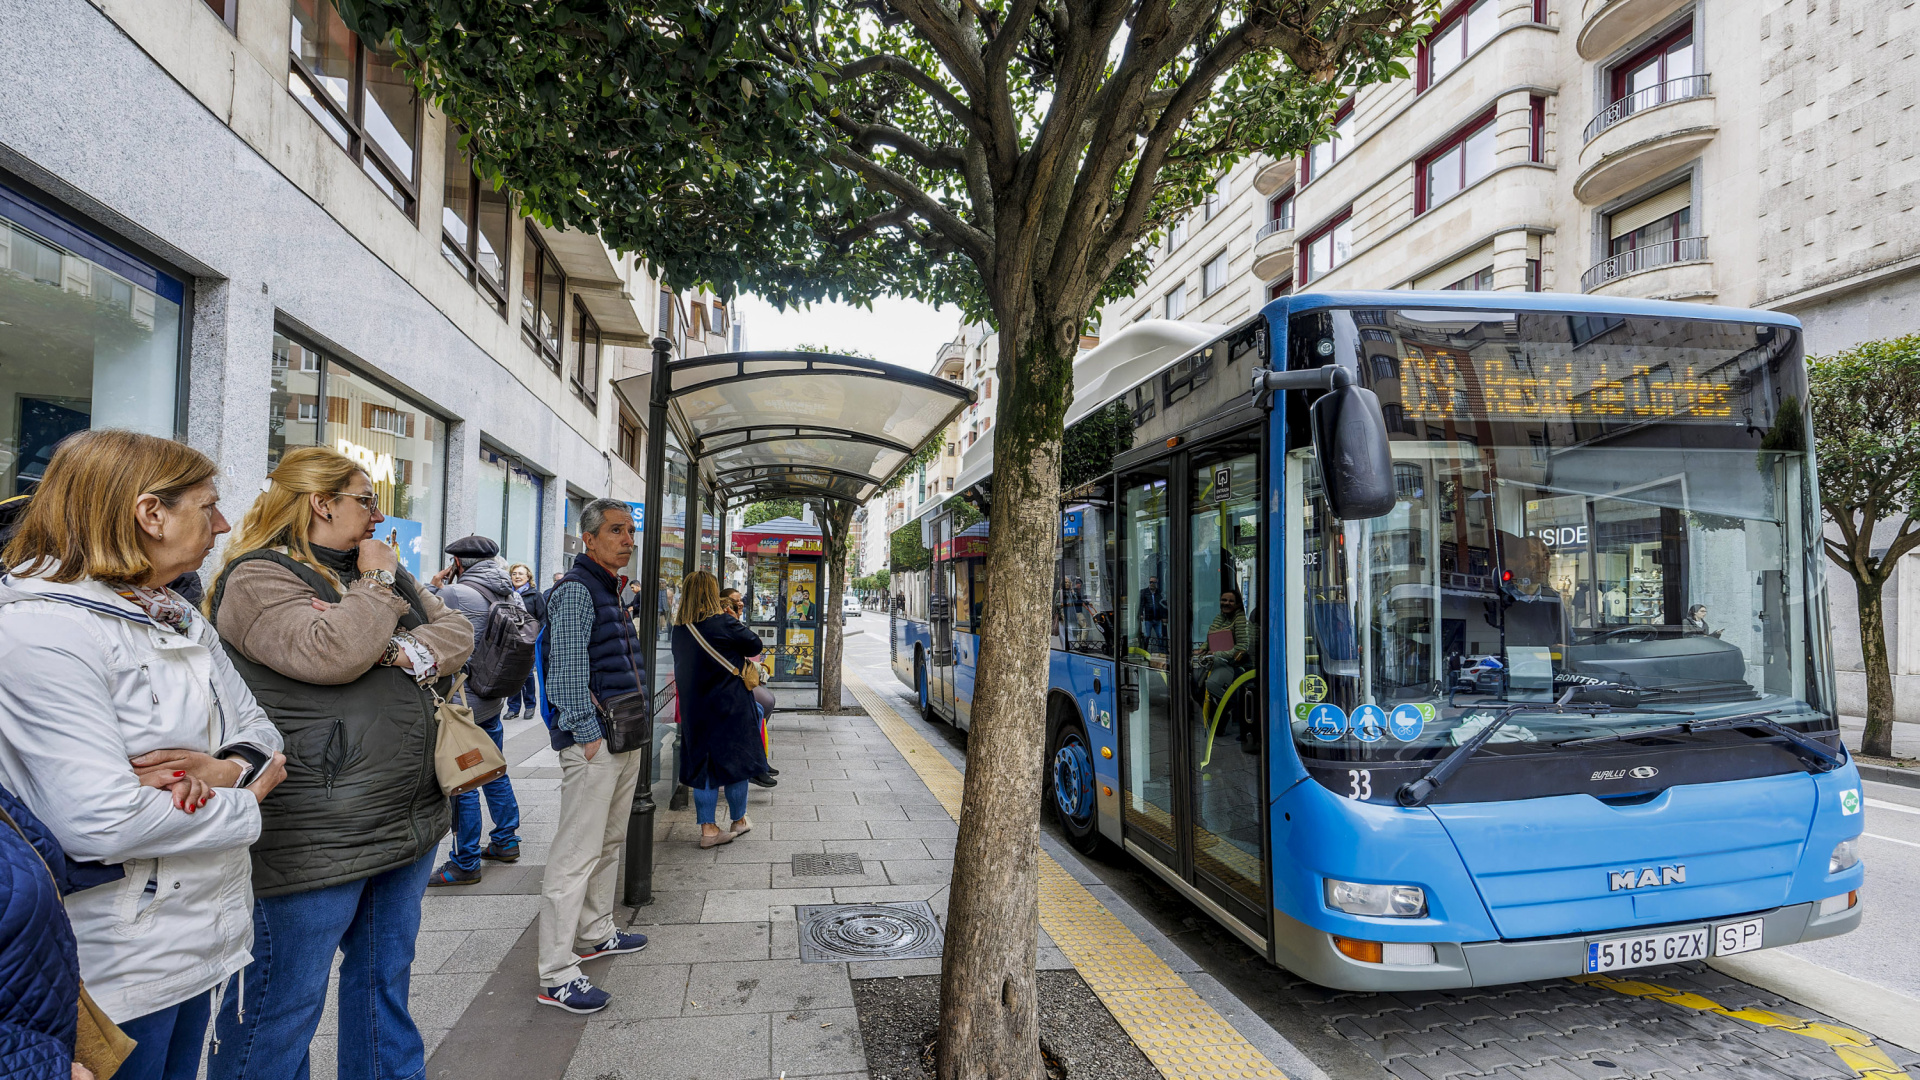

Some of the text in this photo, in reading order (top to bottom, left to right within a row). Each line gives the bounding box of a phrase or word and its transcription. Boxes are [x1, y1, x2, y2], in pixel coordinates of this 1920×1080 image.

[1485, 360, 1582, 413] Resid.
[1591, 364, 1625, 414] de
[1633, 365, 1731, 416] Cortes
[1299, 705, 1306, 716] 2
[1424, 705, 1431, 717] 2
[1348, 769, 1372, 800] 33
[1608, 863, 1686, 891] MAN
[1603, 939, 1656, 967] 5185
[1664, 933, 1703, 960] GZX
